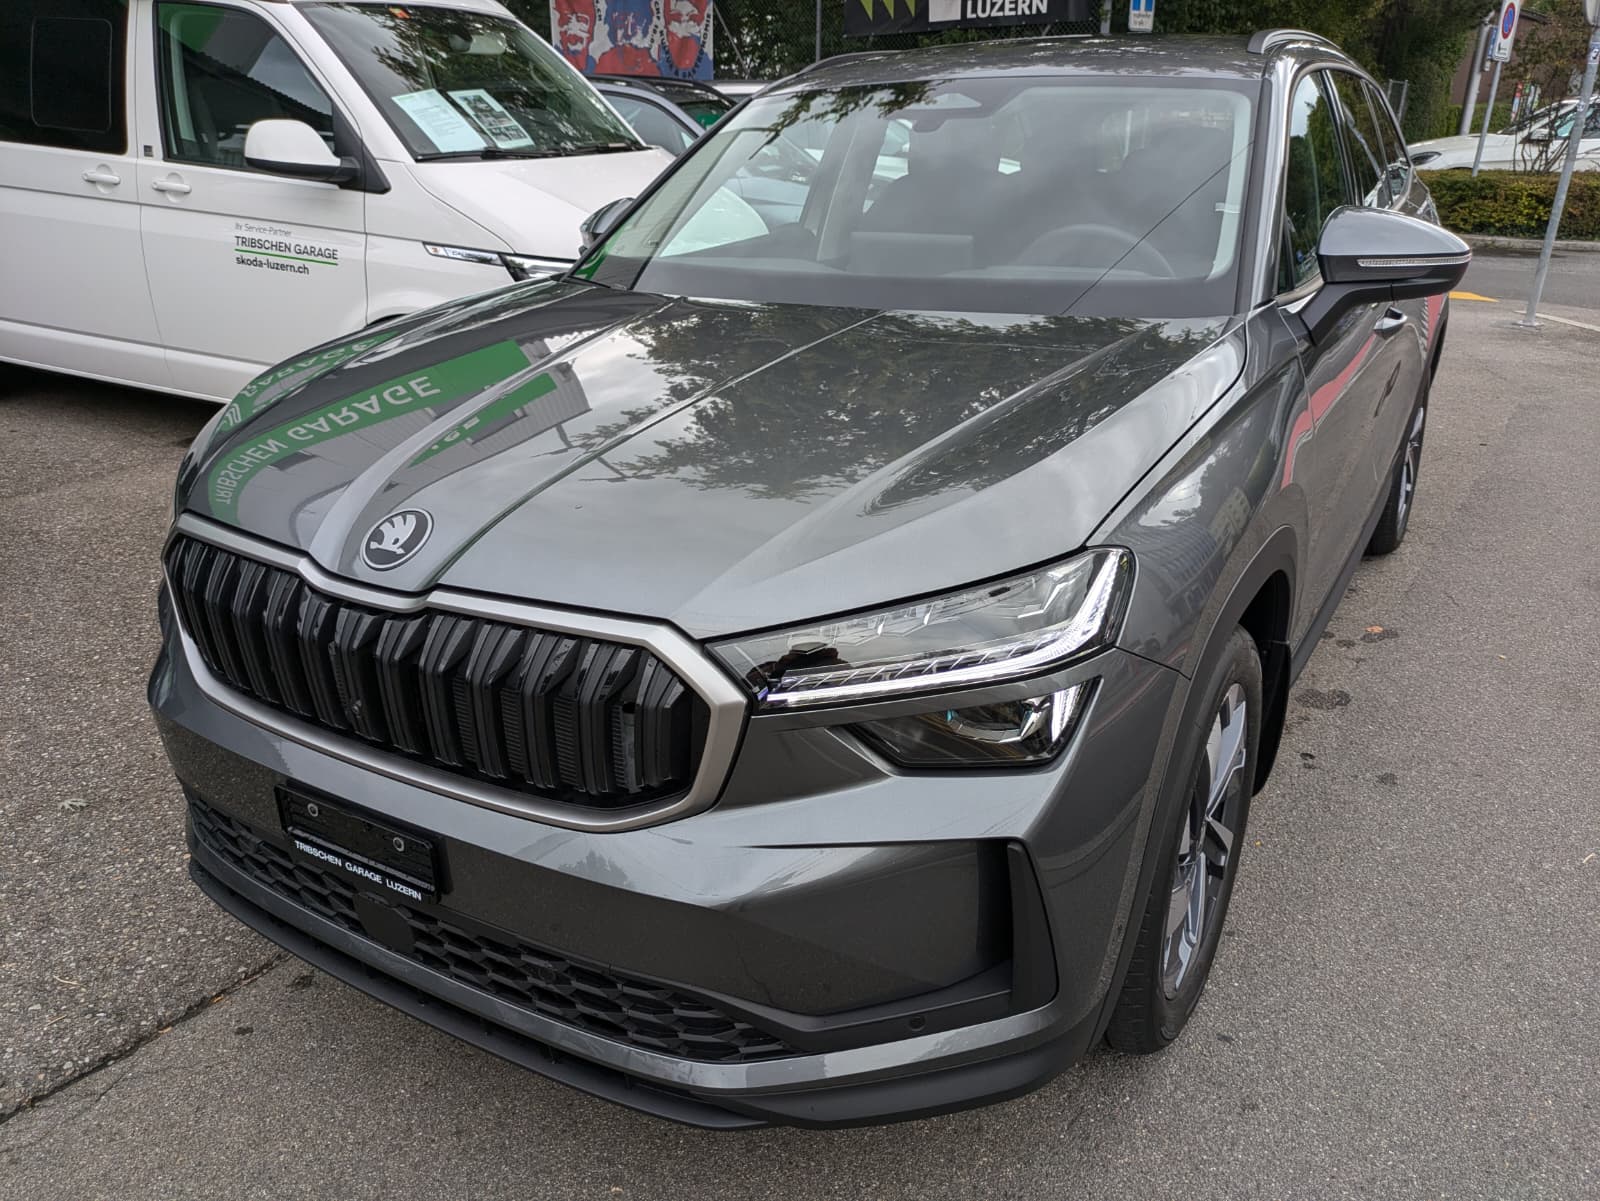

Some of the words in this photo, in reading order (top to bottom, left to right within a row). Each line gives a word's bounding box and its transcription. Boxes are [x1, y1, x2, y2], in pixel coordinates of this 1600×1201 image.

[966, 0, 1049, 19] LUZERN
[234, 235, 292, 253] TRIBSCHEN
[294, 244, 339, 260] GARAGE
[235, 256, 310, 275] skoda-luzern.ch
[294, 840, 342, 867] TRIBSCHEN
[345, 862, 383, 884] GARAGE
[386, 879, 422, 901] LUZERN
